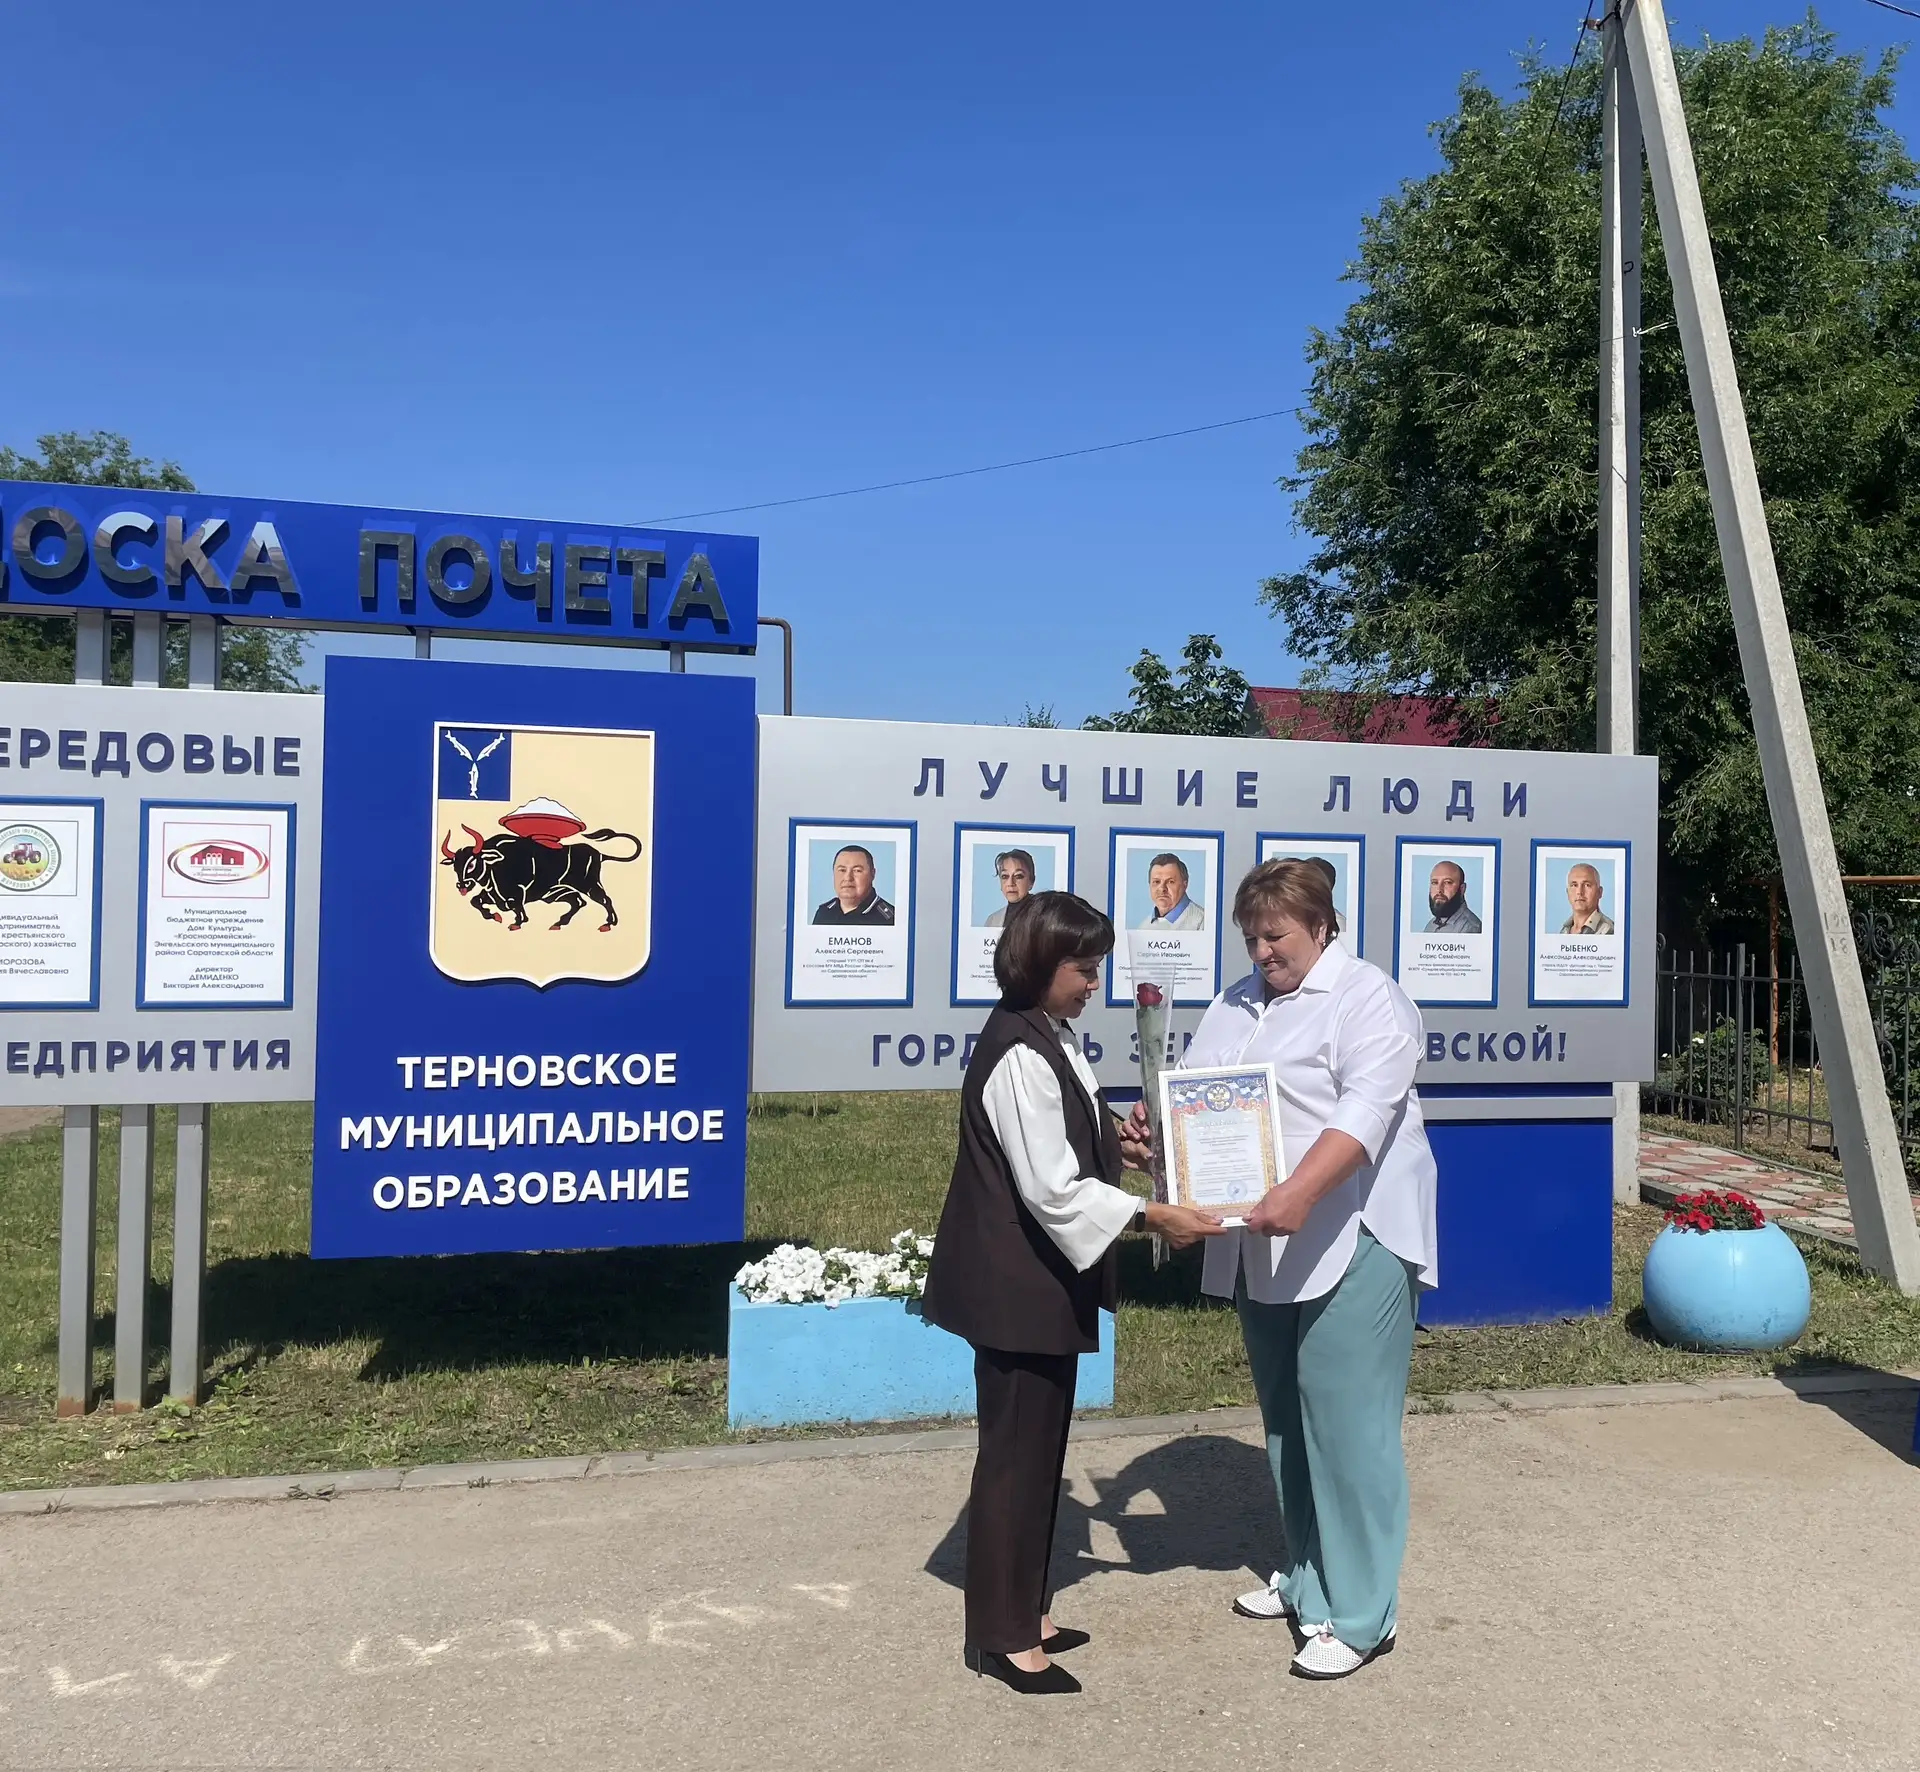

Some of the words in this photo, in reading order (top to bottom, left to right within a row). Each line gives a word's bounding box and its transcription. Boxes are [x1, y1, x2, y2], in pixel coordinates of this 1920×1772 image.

[0, 506, 301, 594] ОСКА
[358, 529, 729, 620] ПОЧЕТА
[914, 757, 1258, 808] ЛУЧШИЕ
[1323, 775, 1528, 822] ЛЮДИ
[184, 908, 247, 916] Муниципальное
[0, 913, 59, 921] ивидуальный
[828, 937, 872, 946] ЕМАНОВ
[1147, 940, 1181, 949] КАСАЙ
[1425, 943, 1466, 951] ПУХОВИЧ
[1560, 944, 1598, 952] РЫБЕНКО
[0, 958, 45, 966] ОРОЗОВА
[7, 1039, 291, 1079] ЕДПРИЯТИЯ
[397, 1053, 677, 1089] ТЕРНОВСКОЕ
[340, 1110, 724, 1151] МУНИЦИПАЛЬНОЕ
[373, 1168, 690, 1210] ОБРАЗОВАНИЕ
